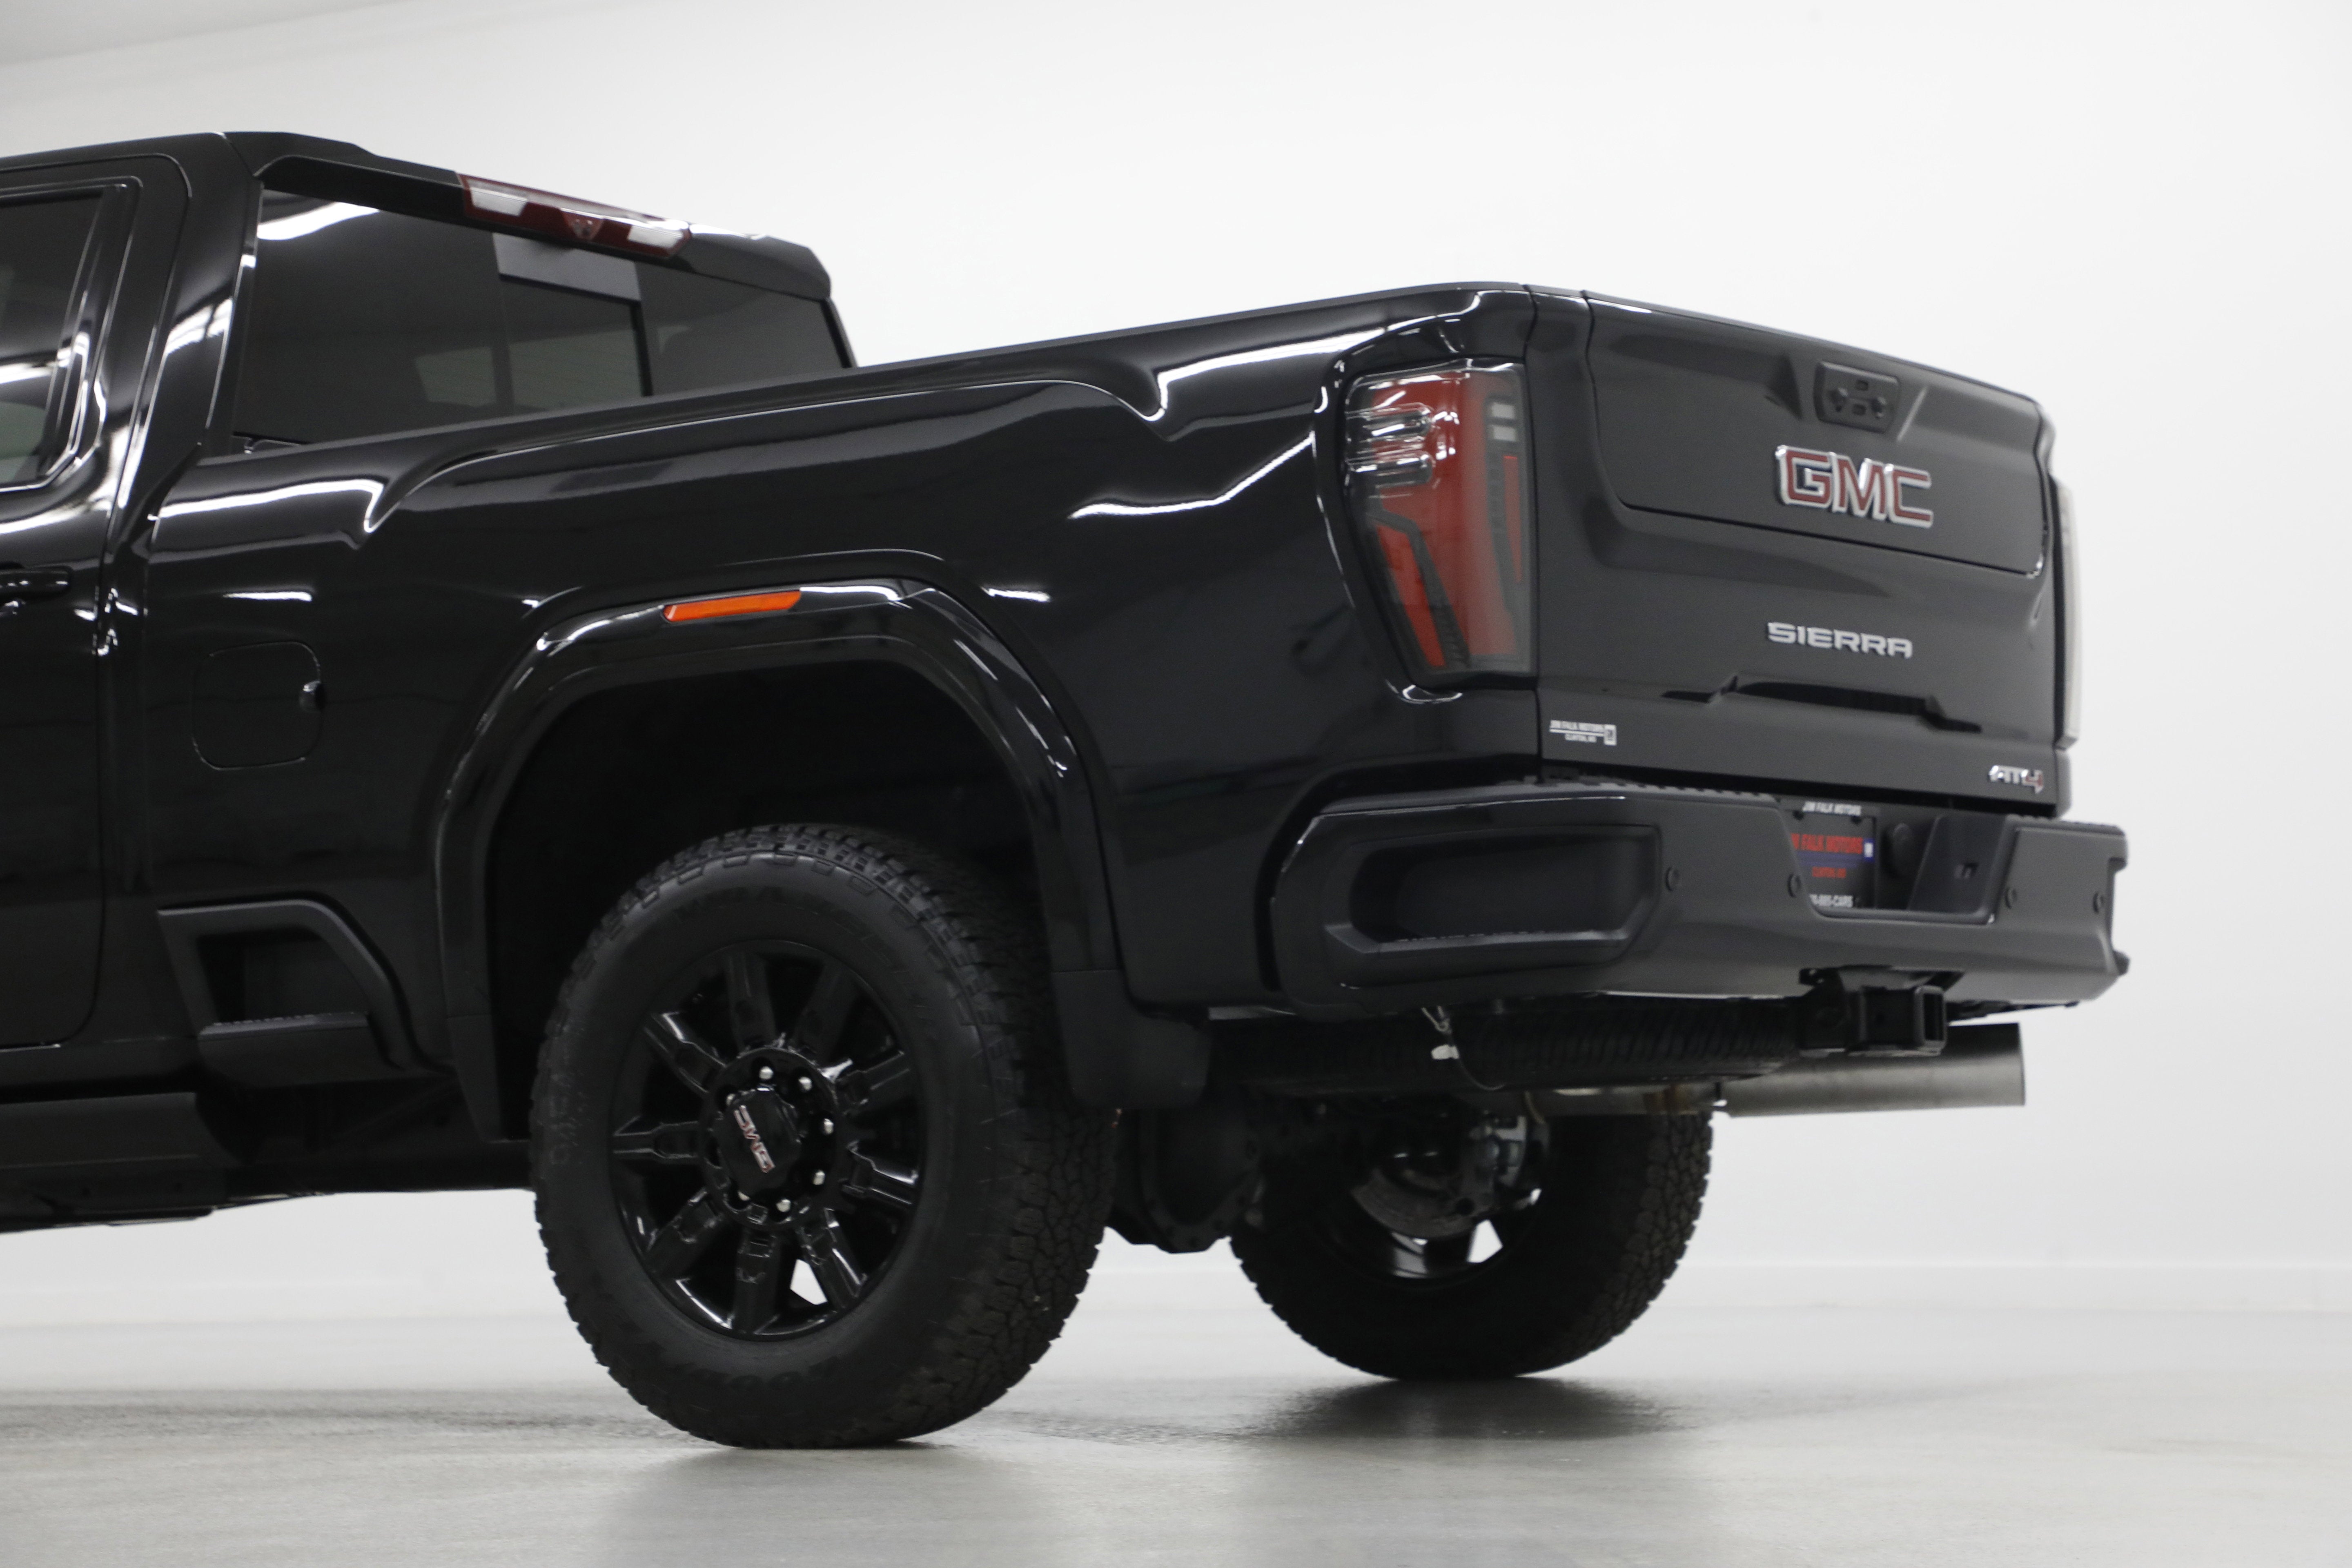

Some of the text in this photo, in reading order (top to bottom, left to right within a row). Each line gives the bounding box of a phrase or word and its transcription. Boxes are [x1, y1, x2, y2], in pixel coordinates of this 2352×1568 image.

[1775, 445, 1933, 528] GMC
[1767, 621, 1913, 659] SIERRA
[1989, 765, 2044, 794] AT4
[1816, 802, 1833, 813] FALK
[1834, 803, 1861, 816] MOTORS
[1801, 834, 1824, 851] FALK
[1826, 835, 1863, 854] MOTORS
[734, 1105, 775, 1173] GMC
